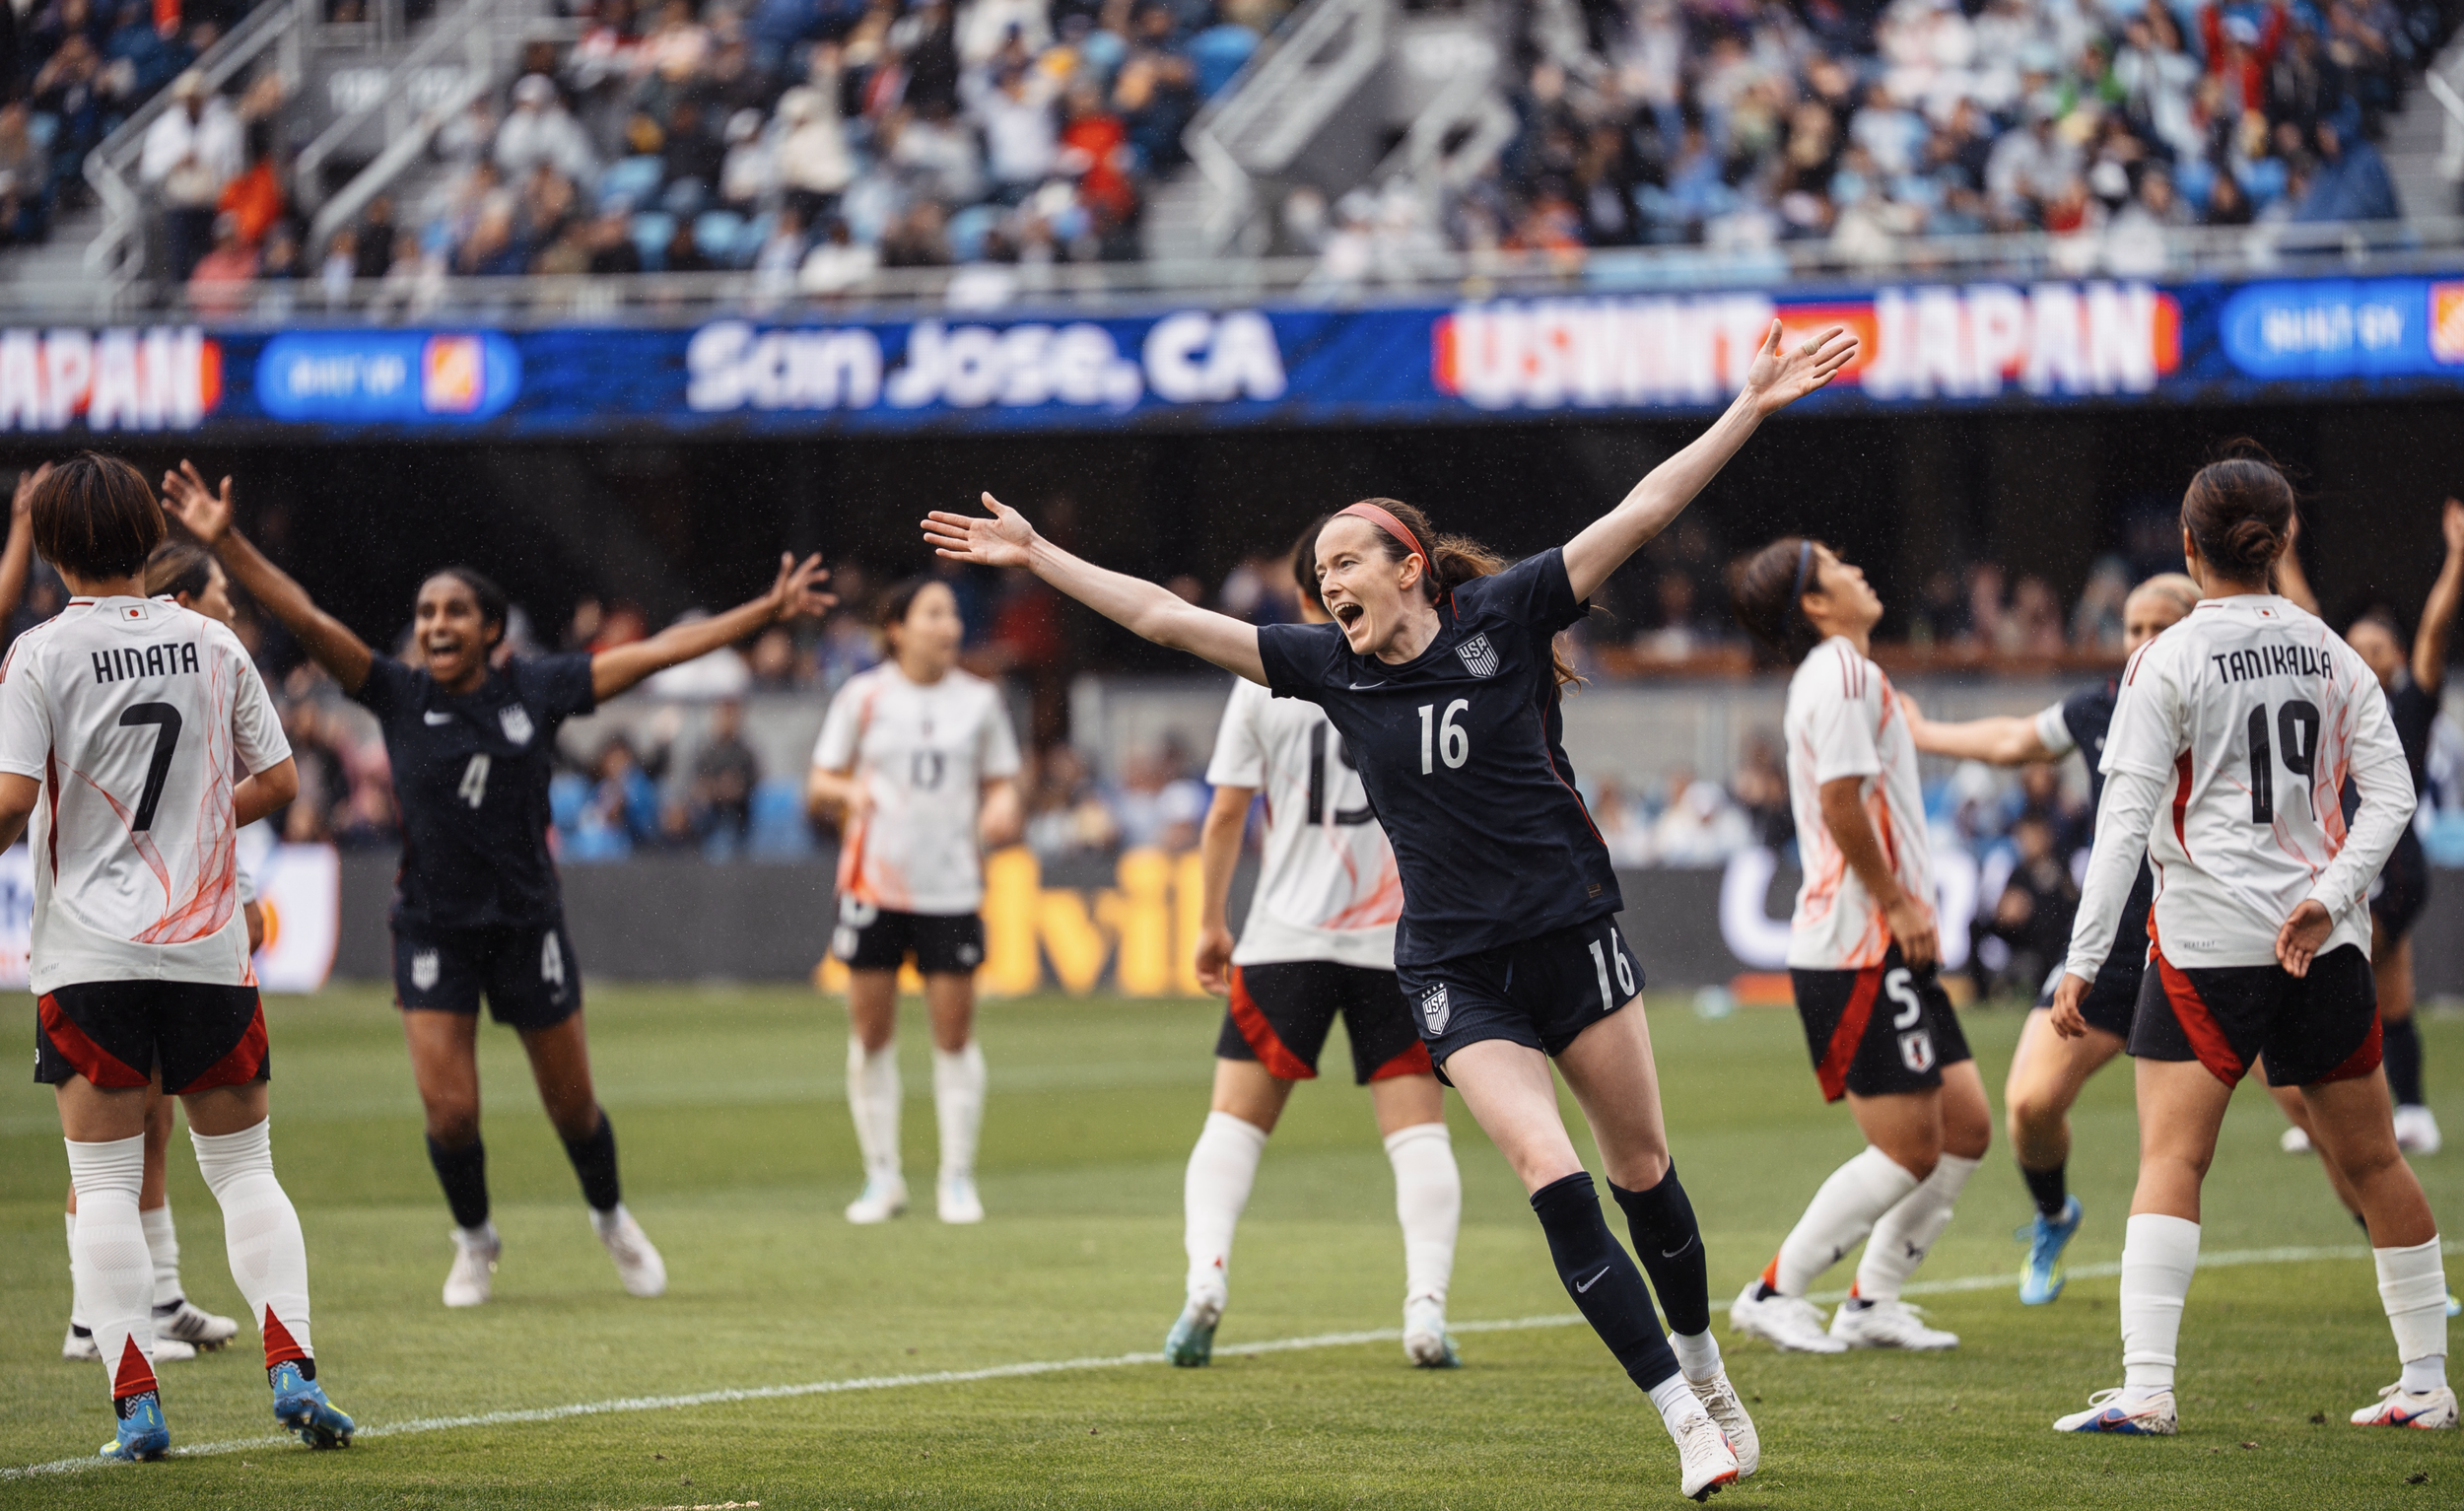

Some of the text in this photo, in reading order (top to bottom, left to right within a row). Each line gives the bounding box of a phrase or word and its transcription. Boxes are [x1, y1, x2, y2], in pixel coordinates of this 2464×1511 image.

[688, 309, 1288, 415] San Jose, CA
[1860, 279, 2159, 400] JAPAN
[91, 642, 200, 684] HINATA
[1459, 636, 1487, 658] USA
[2212, 644, 2334, 685] TANIKAWA
[119, 702, 183, 832] 7
[1417, 698, 1470, 776] 16
[2248, 699, 2321, 825] 19
[457, 753, 492, 808] 4
[541, 929, 565, 986] 4
[1588, 927, 1636, 1011] 16
[1424, 992, 1446, 1014] USA
[1884, 967, 1922, 1031] 5
